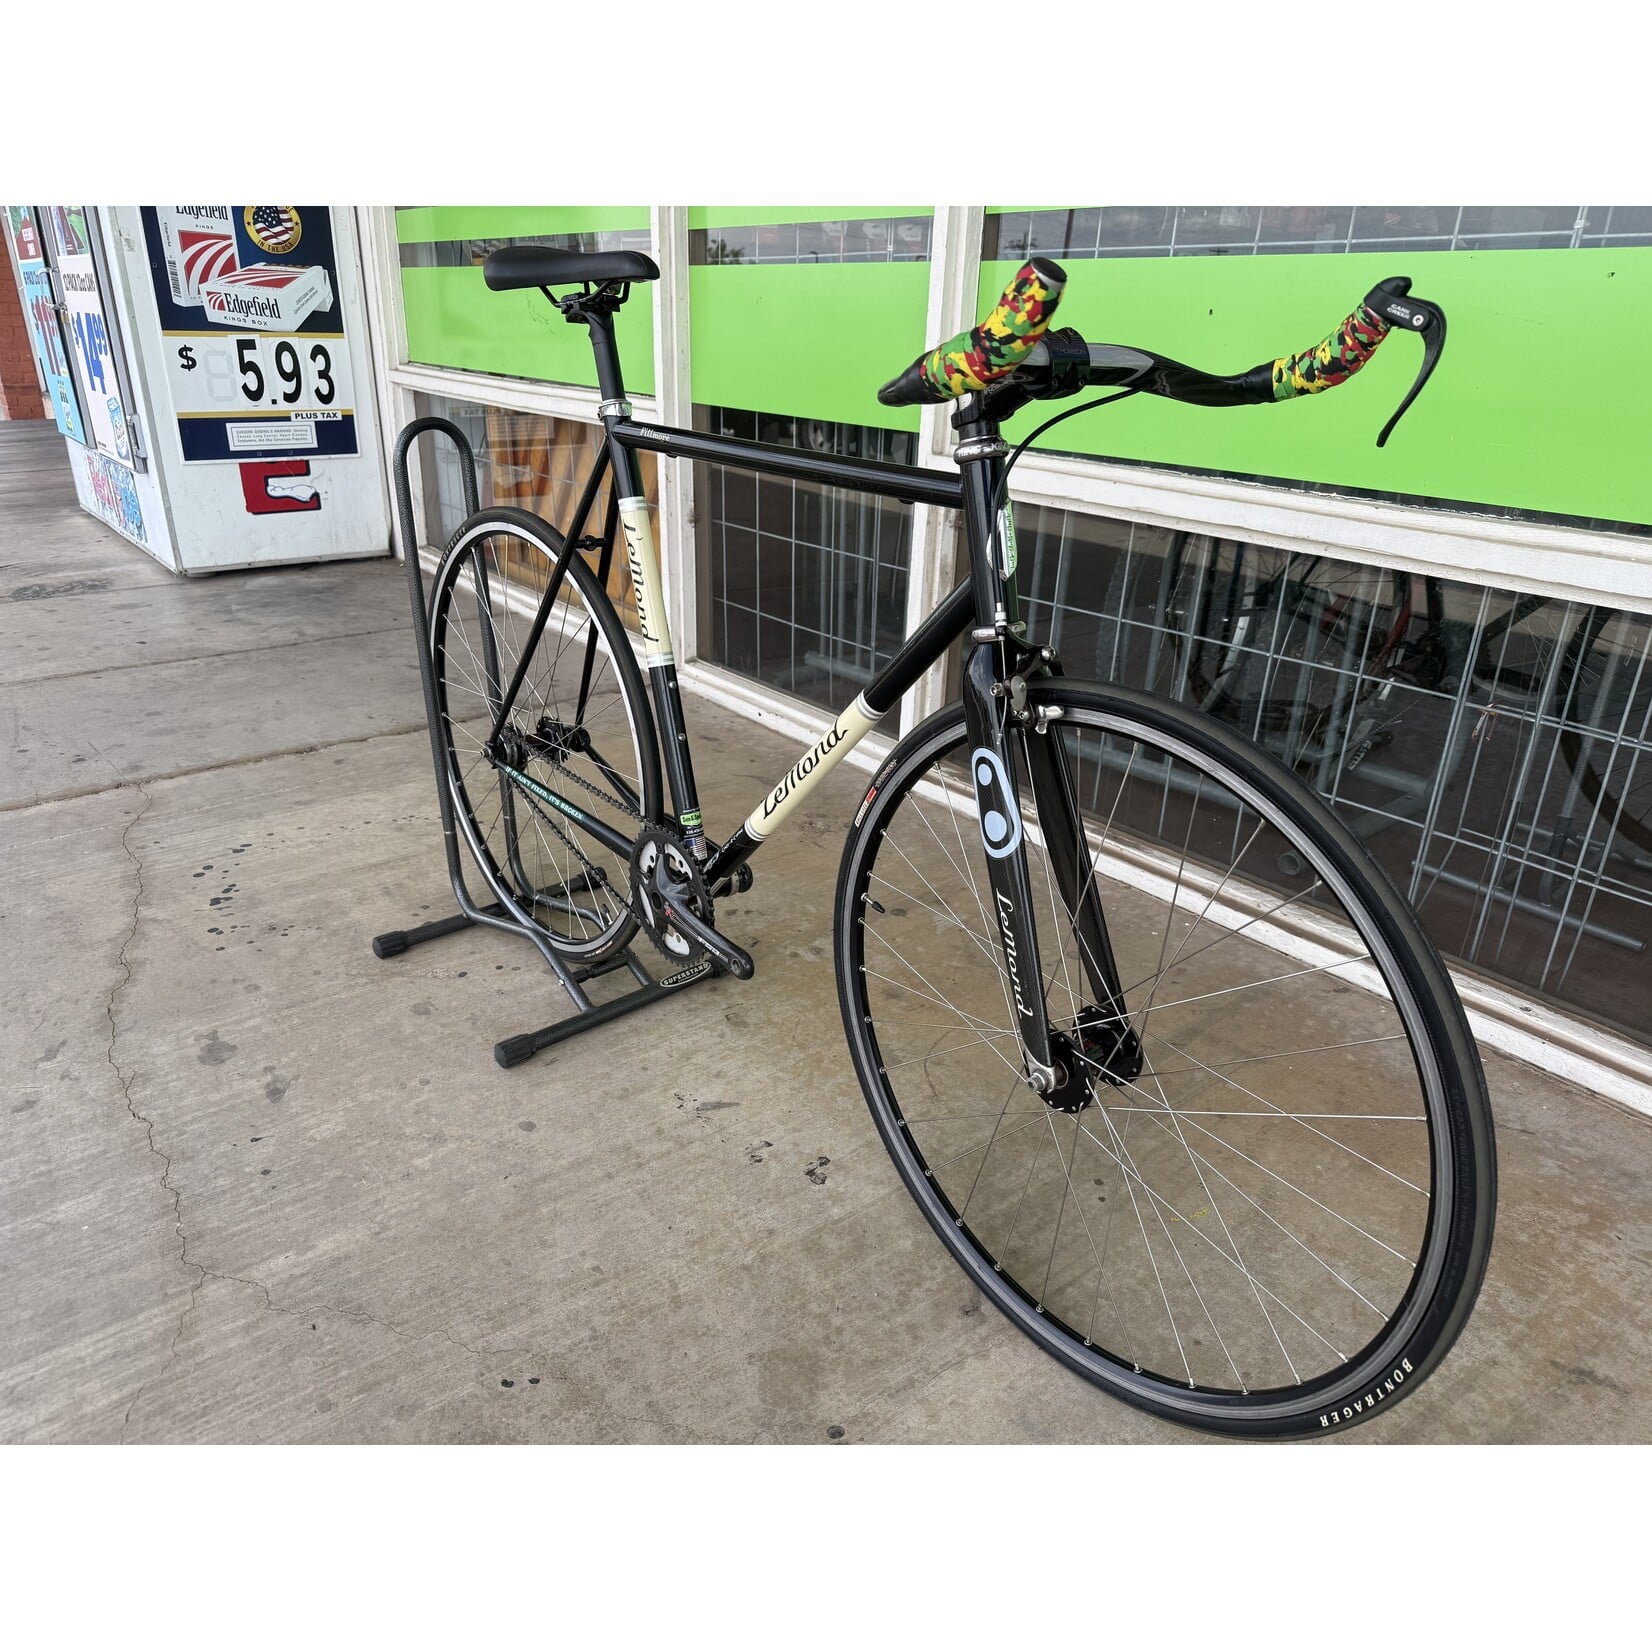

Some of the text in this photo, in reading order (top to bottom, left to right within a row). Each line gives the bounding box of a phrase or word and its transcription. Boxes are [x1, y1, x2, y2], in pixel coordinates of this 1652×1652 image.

[257, 239, 294, 253] IN THE USA
[223, 292, 281, 319] Edgefield
[1386, 307, 1410, 319] CREEK
[1391, 303, 1410, 314] CANE
[223, 315, 268, 327] KINGS BOX
[178, 338, 335, 405] $ 5.93
[320, 411, 339, 419] TAX
[640, 426, 670, 442] Fillmore
[559, 802, 584, 820] BROKEN
[663, 963, 709, 986] SUPERSTAND
[1320, 1357, 1413, 1427] BONTRAGER
